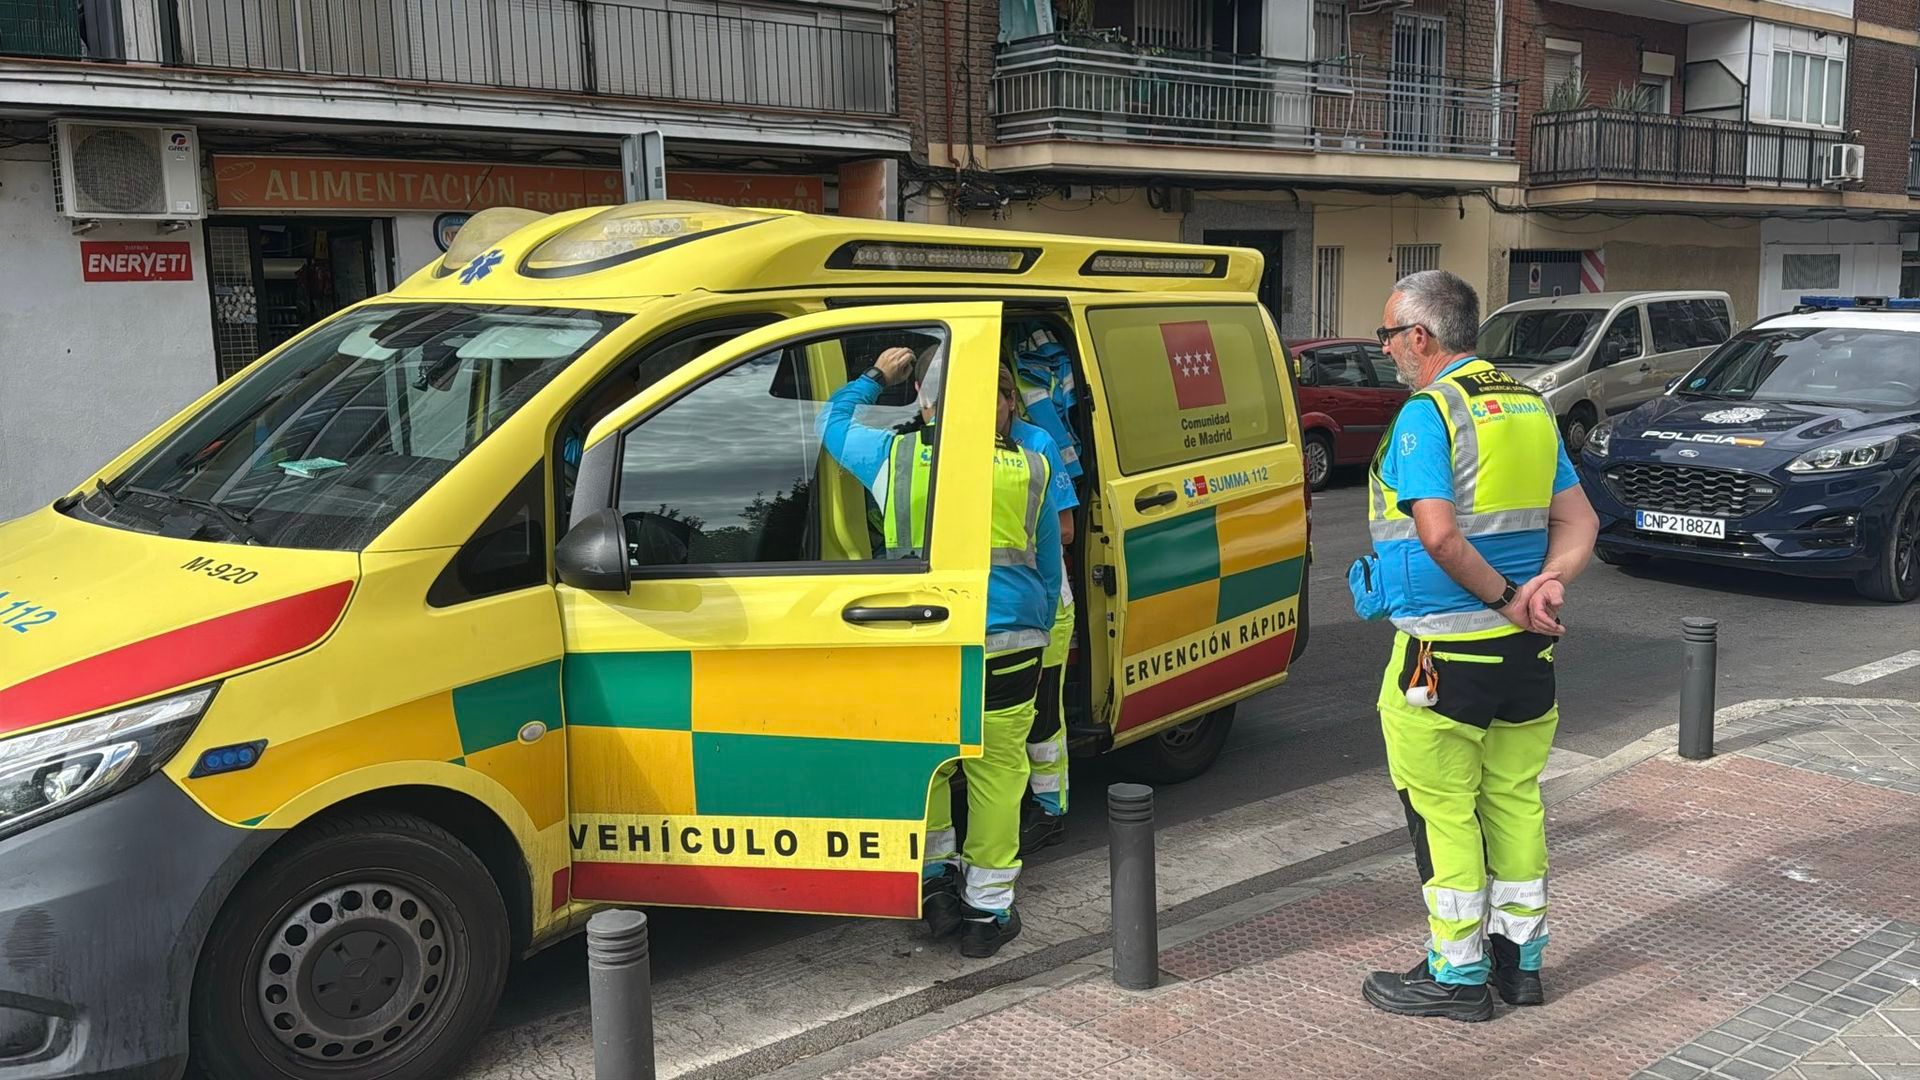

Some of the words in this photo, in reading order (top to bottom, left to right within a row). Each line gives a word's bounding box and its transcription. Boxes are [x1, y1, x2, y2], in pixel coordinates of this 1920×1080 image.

[264, 165, 516, 206] ALIMENTACIÓN
[523, 191, 624, 212] FRUTERI
[88, 252, 187, 277] ENERYETI
[1467, 370, 1520, 385] TECNI
[1181, 411, 1230, 430] Comunidad
[1184, 434, 1197, 448] de
[1198, 428, 1232, 446] Madrid
[1641, 430, 1736, 445] POLICIA
[1004, 458, 1024, 468] 112
[1209, 471, 1250, 493] SUMMA
[1251, 466, 1269, 482] 112
[1644, 513, 1722, 536] CNP2188ZA
[181, 556, 259, 585] M-920
[1125, 631, 1231, 686] ERVENCIÓN
[1239, 608, 1296, 644] RÁPIDA
[569, 820, 798, 857] VEHÍCULO
[827, 831, 881, 859] DE
